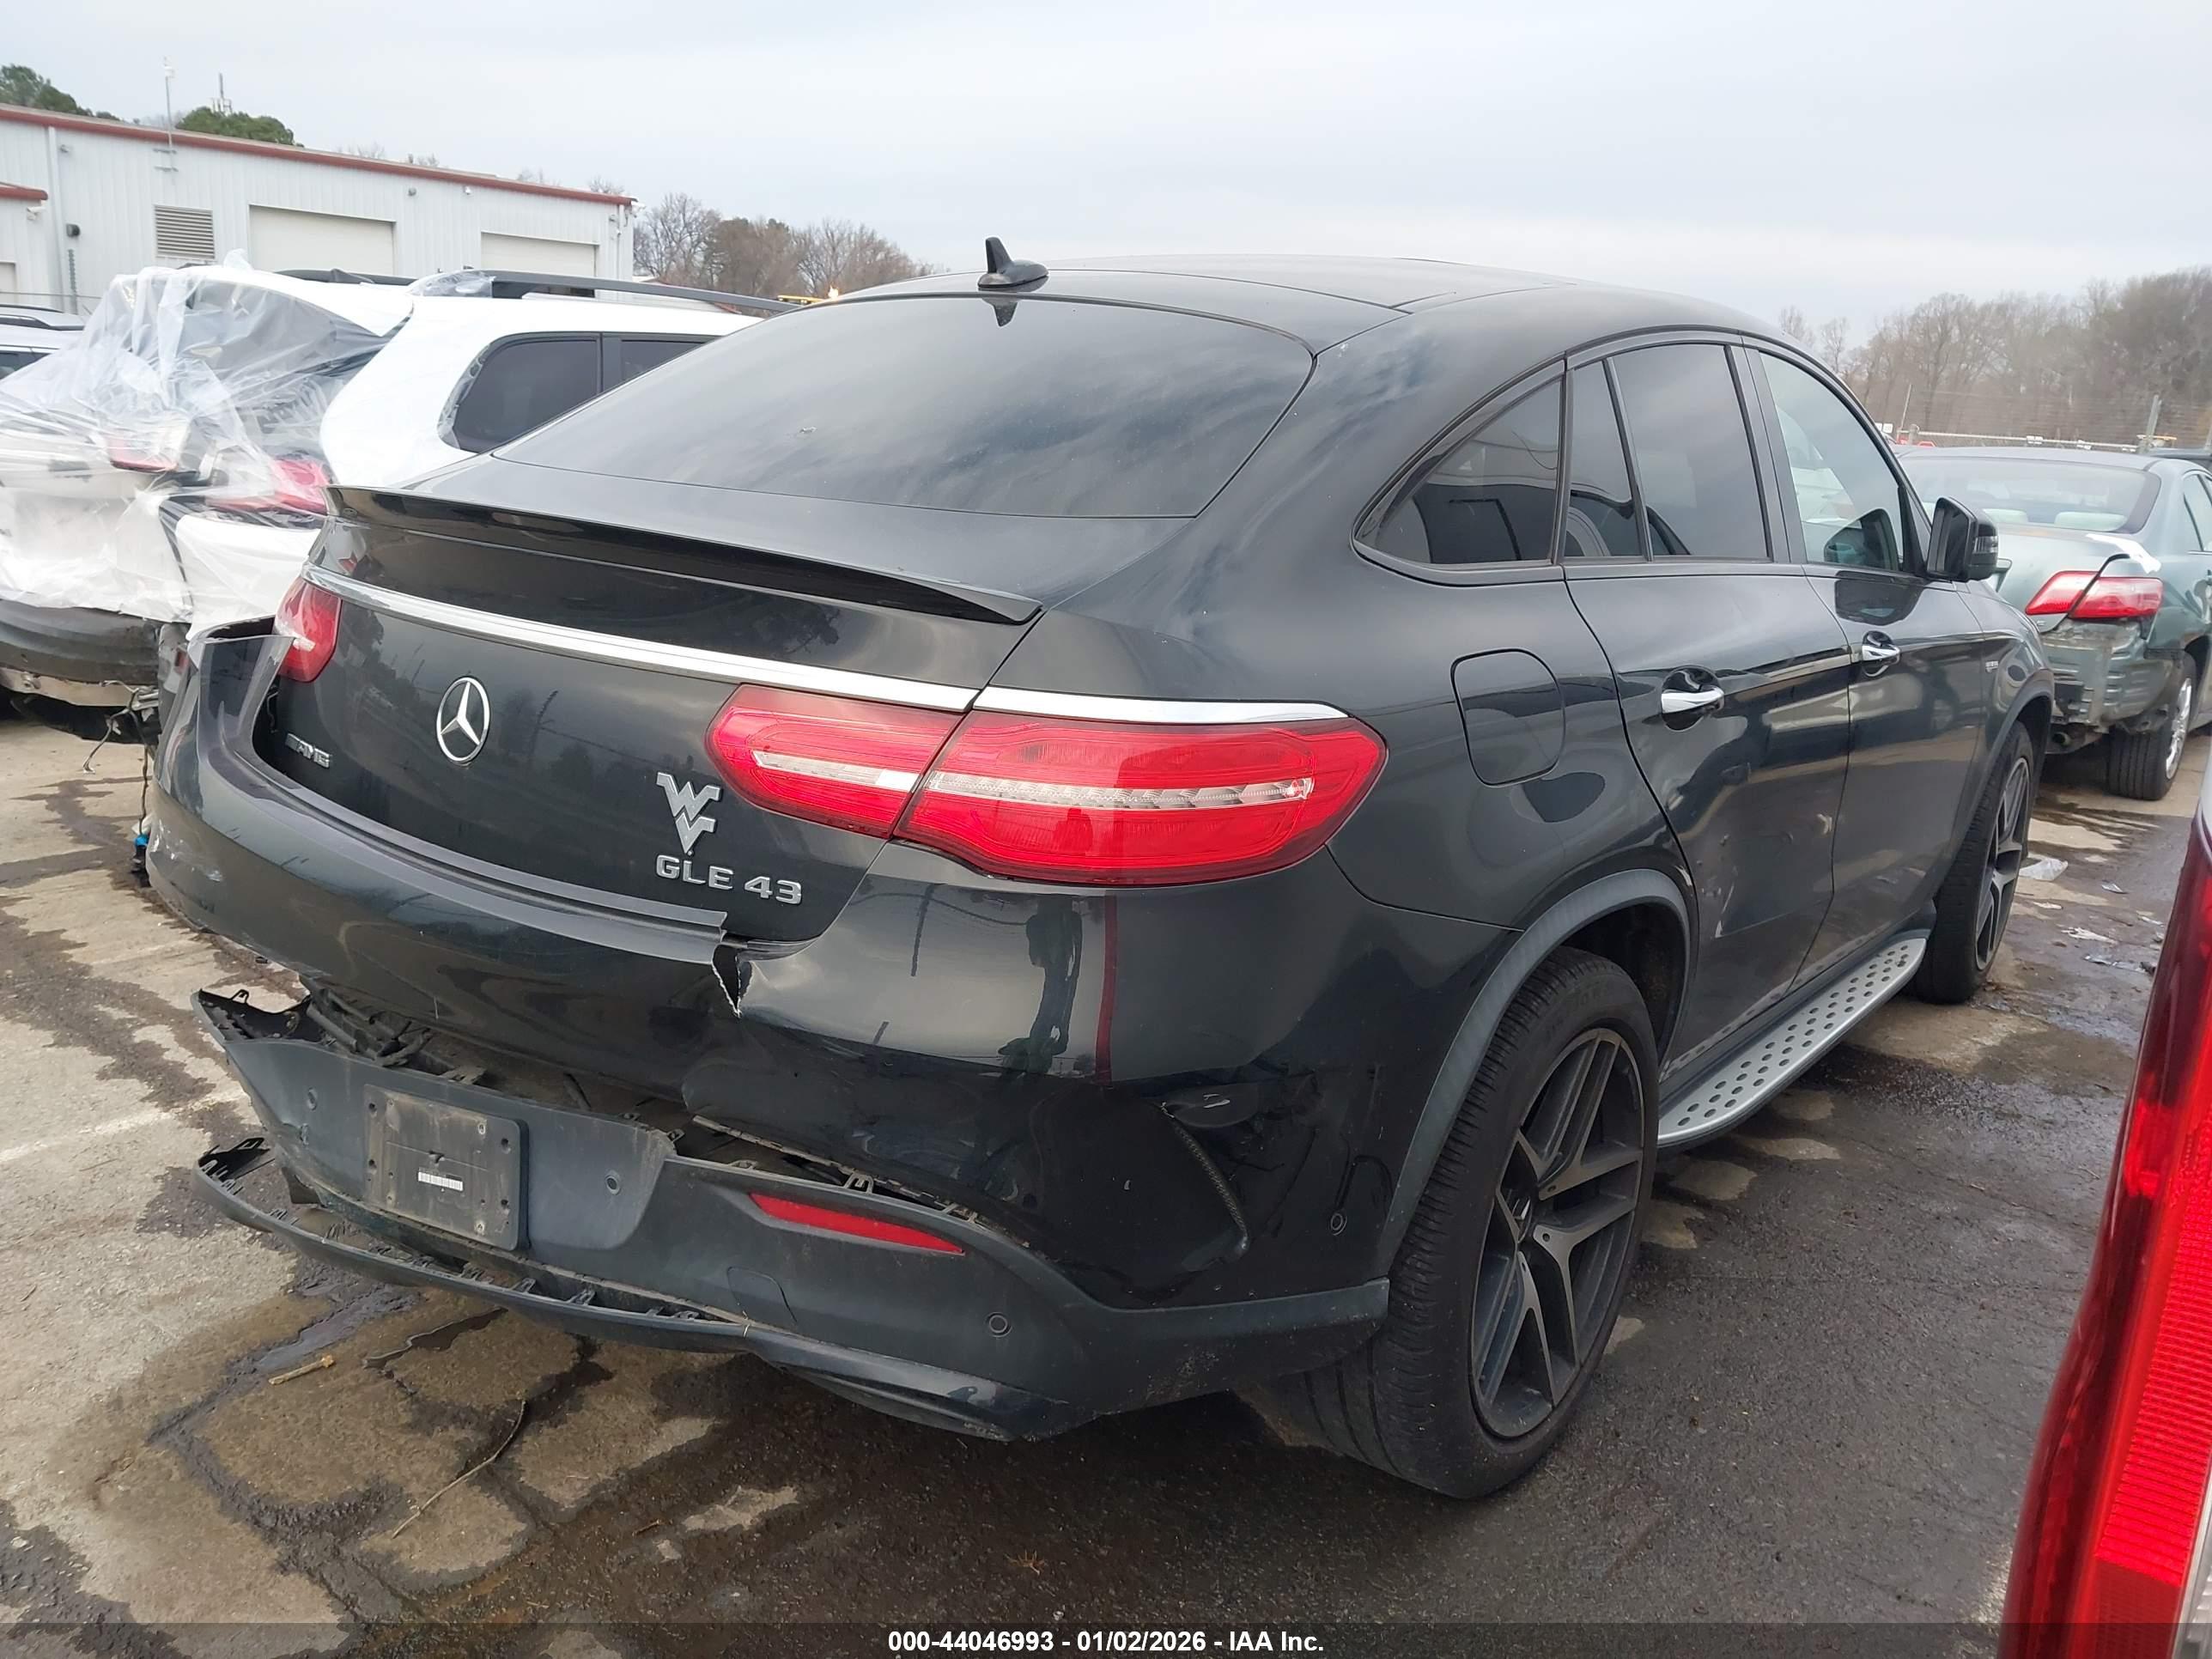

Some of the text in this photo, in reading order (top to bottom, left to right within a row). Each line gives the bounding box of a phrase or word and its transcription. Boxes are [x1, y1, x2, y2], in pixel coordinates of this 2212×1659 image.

[295, 738, 330, 769] AMG
[656, 854, 802, 904] GLE 43
